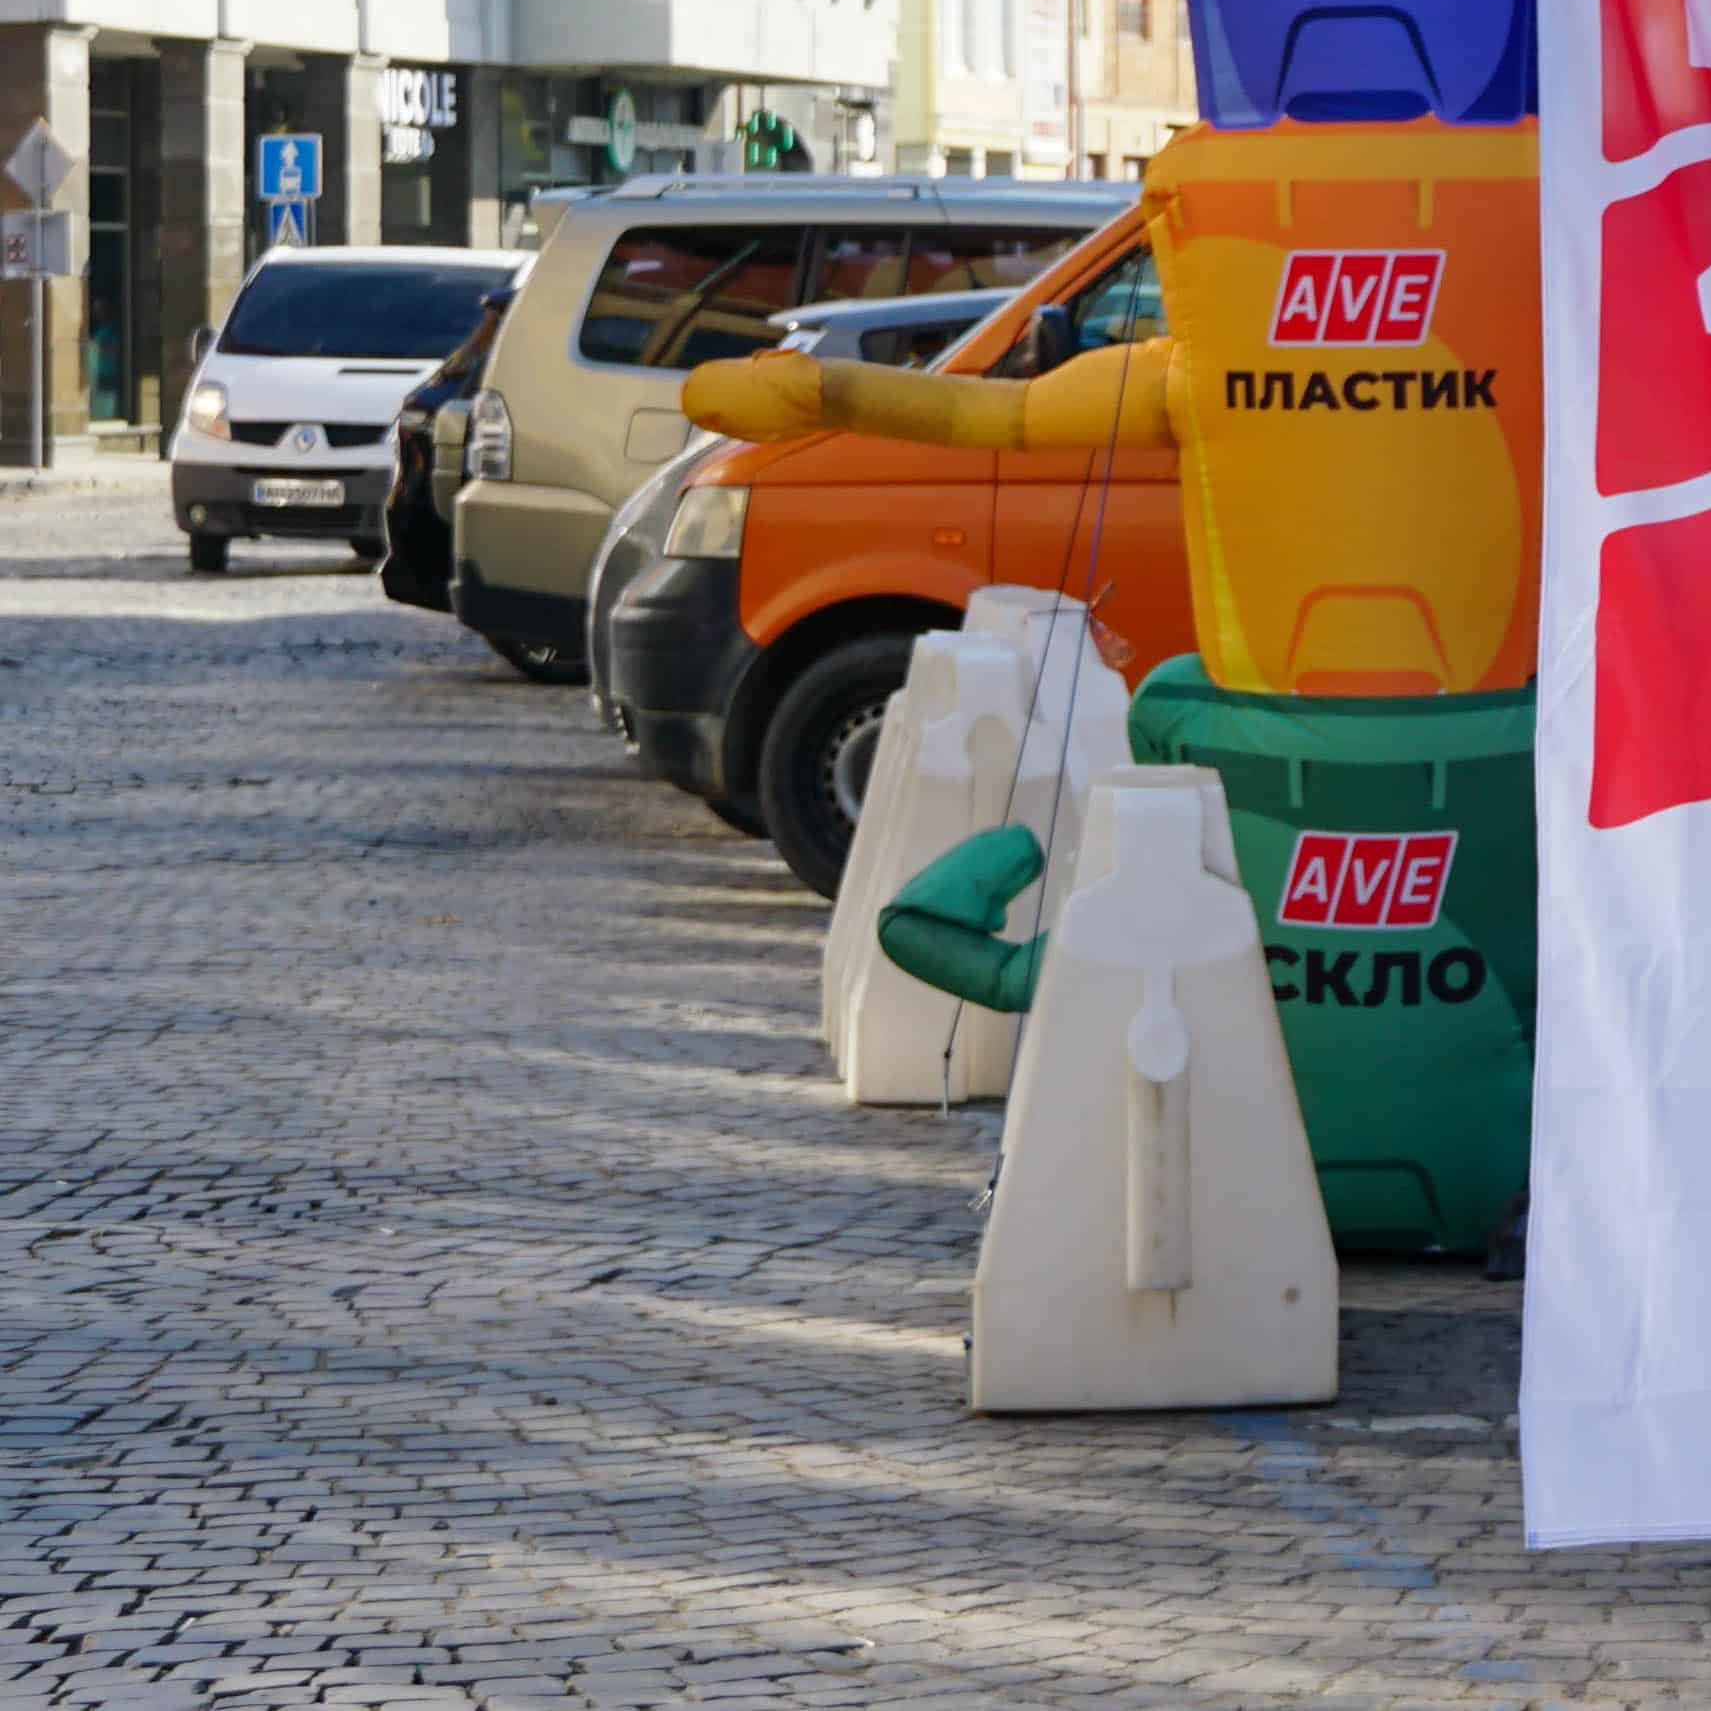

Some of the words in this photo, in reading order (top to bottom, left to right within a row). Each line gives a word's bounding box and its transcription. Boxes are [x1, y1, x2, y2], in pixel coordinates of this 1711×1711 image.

[1281, 274, 1430, 322] AVE
[1225, 369, 1499, 412] ПЛАСТИК
[1291, 855, 1442, 906] AVE
